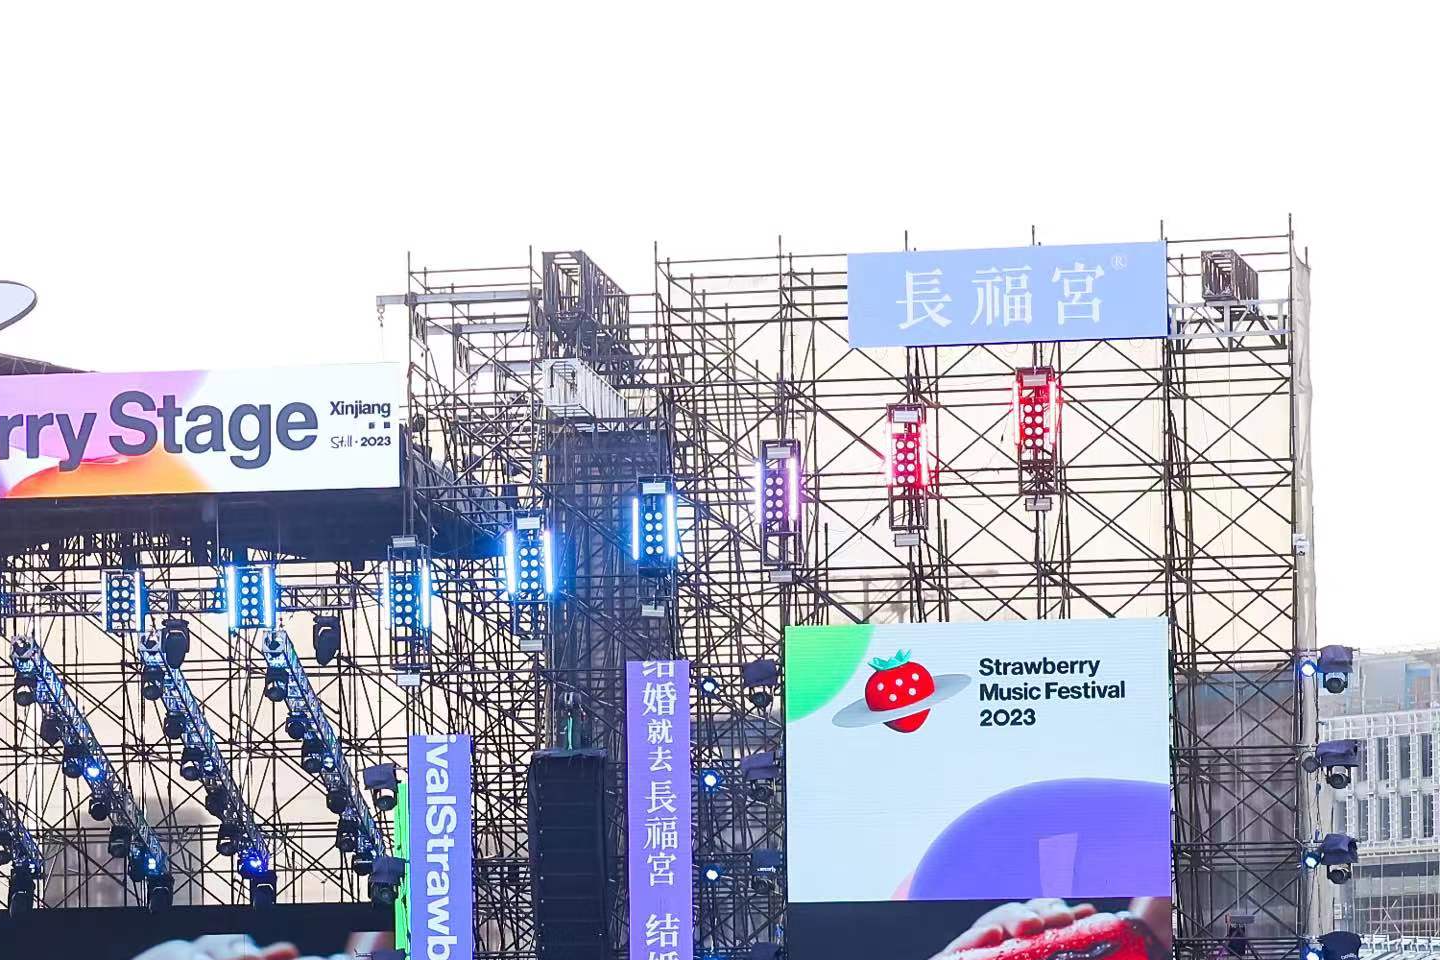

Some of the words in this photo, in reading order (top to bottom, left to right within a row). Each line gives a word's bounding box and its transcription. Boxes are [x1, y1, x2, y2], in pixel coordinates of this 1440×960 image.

[896, 262, 1105, 329] 長福宮
[330, 400, 391, 418] Xinjiang
[109, 391, 318, 469] Stage
[361, 436, 391, 447] 2023
[979, 657, 1100, 677] Strawberry
[979, 683, 1041, 701] Music
[1045, 681, 1125, 699] Festival
[980, 708, 1036, 726] 2023
